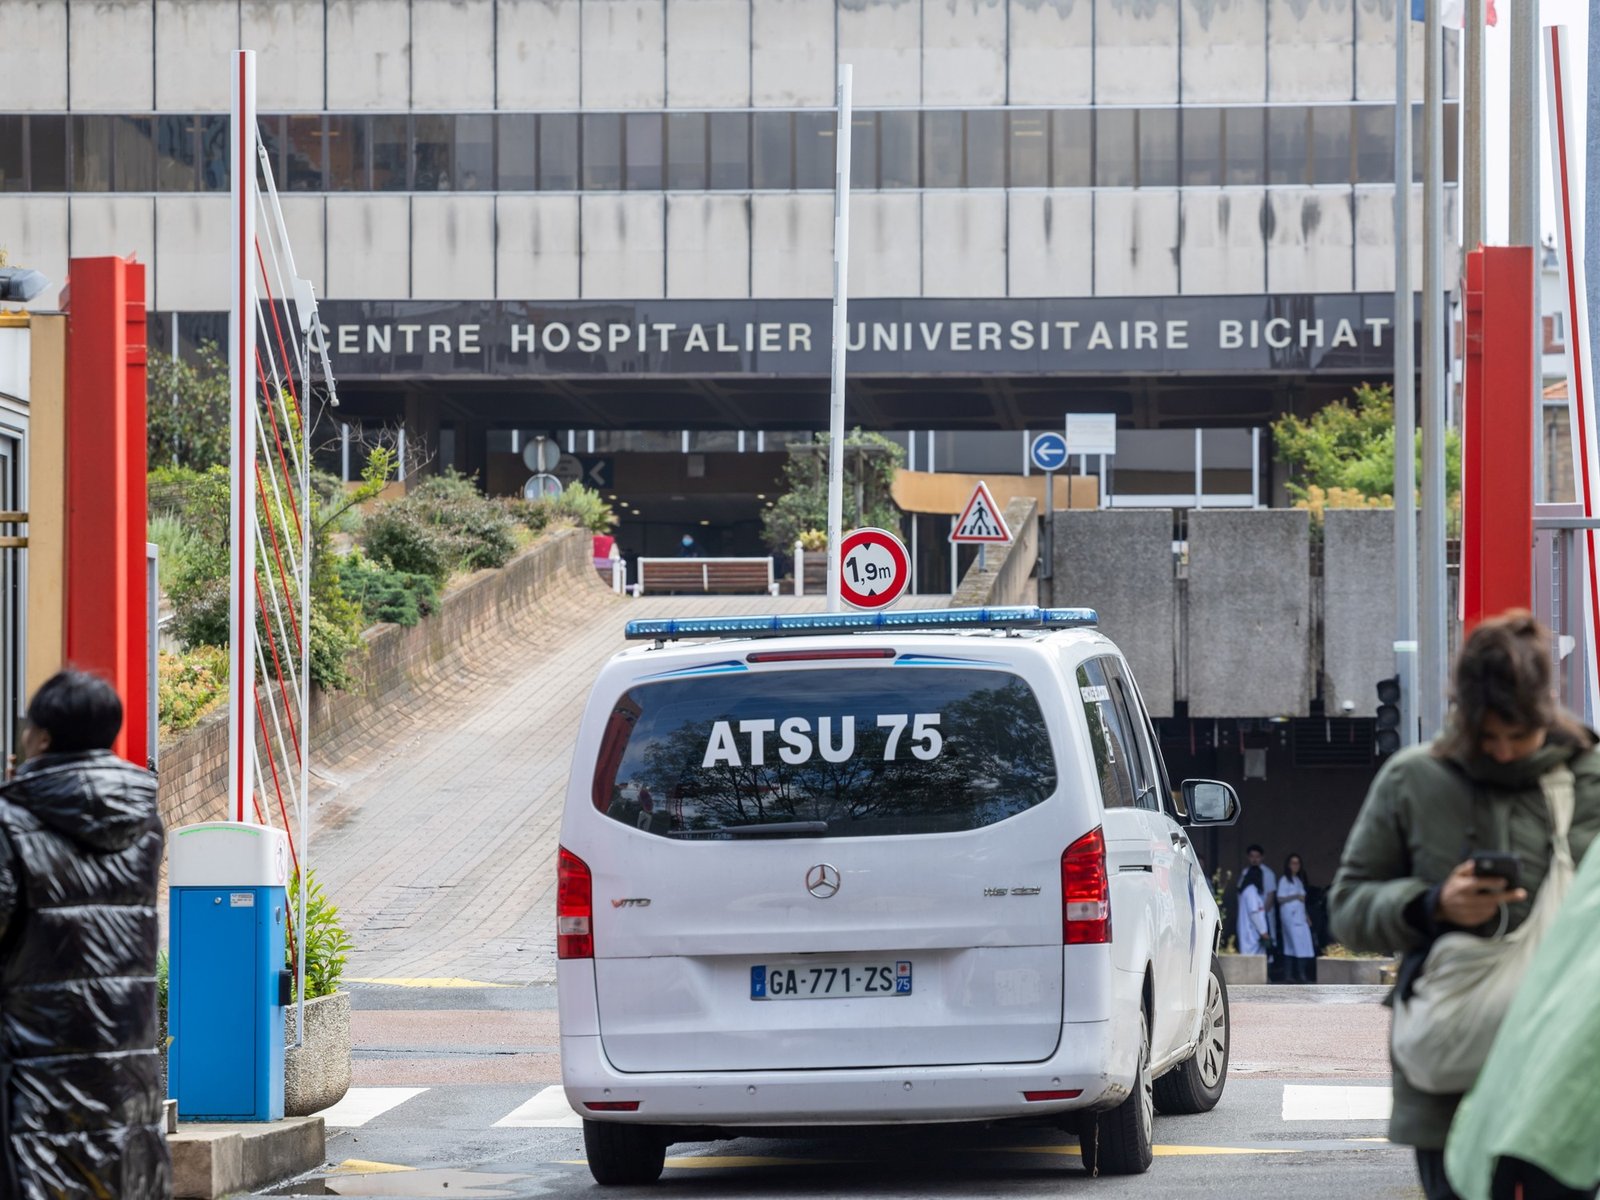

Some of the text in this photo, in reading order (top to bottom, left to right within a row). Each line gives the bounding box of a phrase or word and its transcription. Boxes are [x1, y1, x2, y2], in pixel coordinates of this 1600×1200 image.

[309, 317, 1390, 353] CENTRE HOSPITALIER UNIVERSITAIRE BICHAT
[702, 713, 942, 768] ATSU 75
[770, 967, 893, 995] GA-771-ZS
[897, 978, 910, 991] 75
